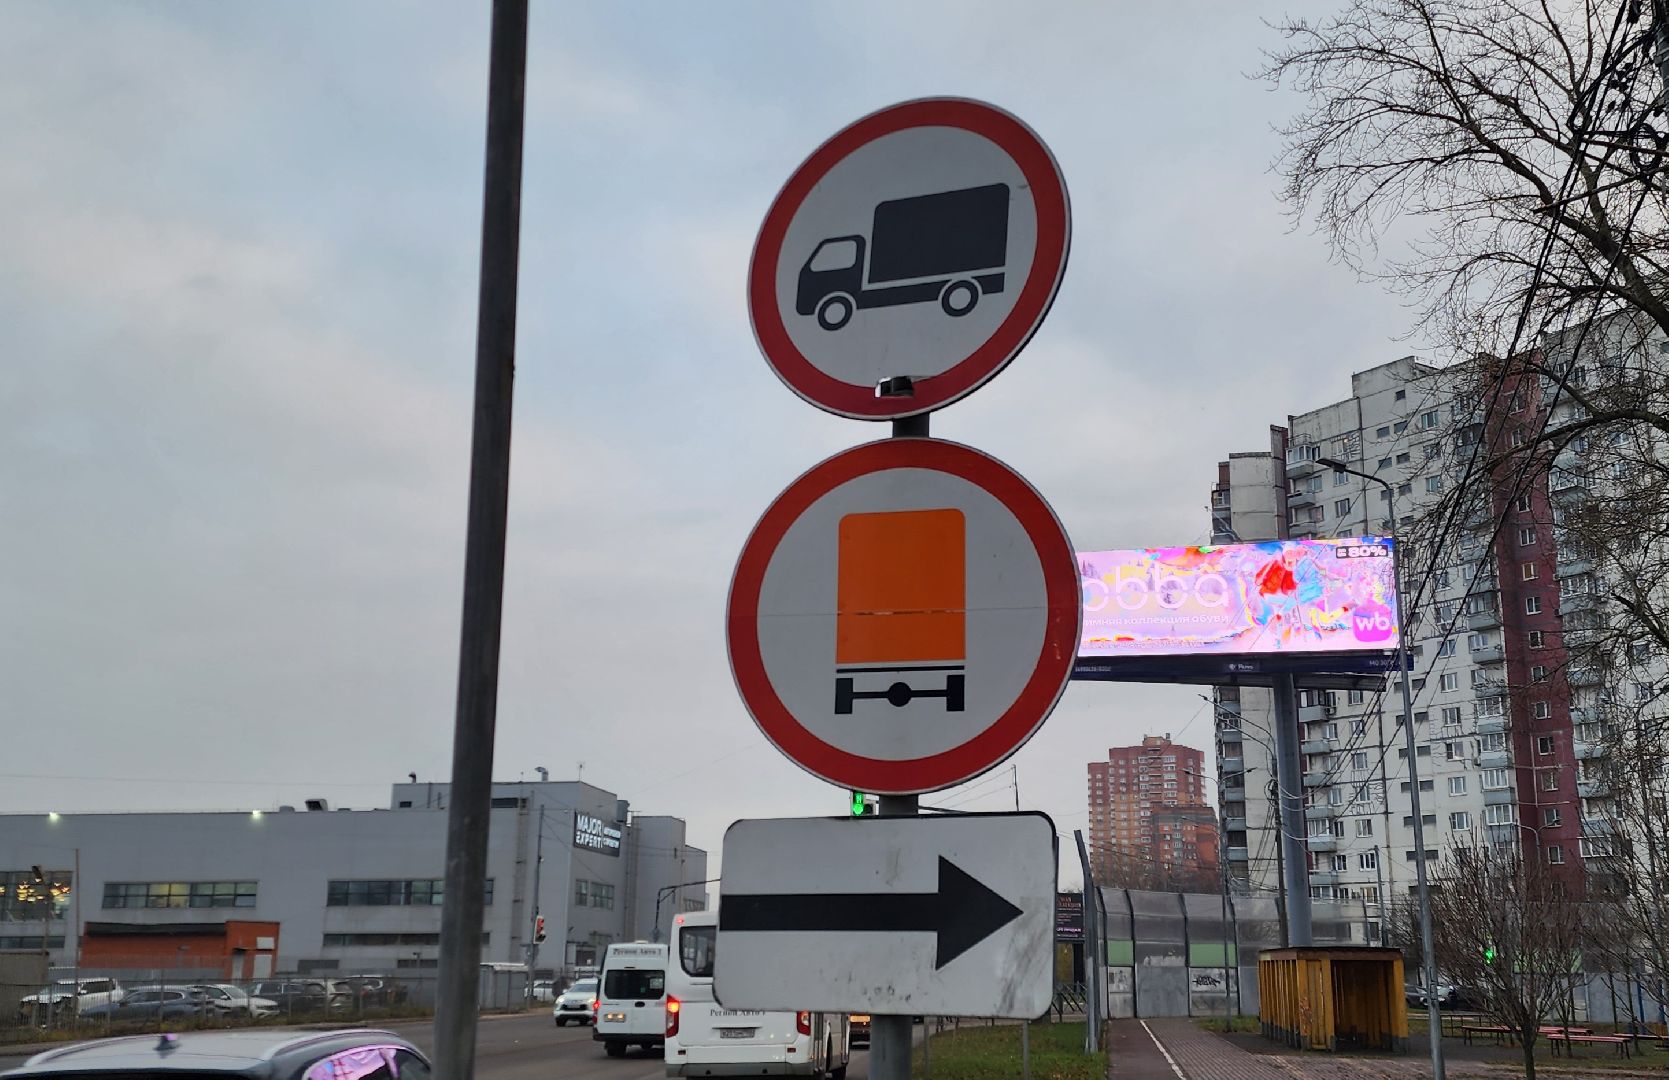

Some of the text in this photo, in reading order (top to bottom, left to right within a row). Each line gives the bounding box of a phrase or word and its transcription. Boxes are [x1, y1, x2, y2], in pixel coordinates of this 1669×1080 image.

[1084, 614, 1229, 626] имная коллекция обуви
[1355, 611, 1391, 631] wb
[577, 814, 602, 837] MAJOR
